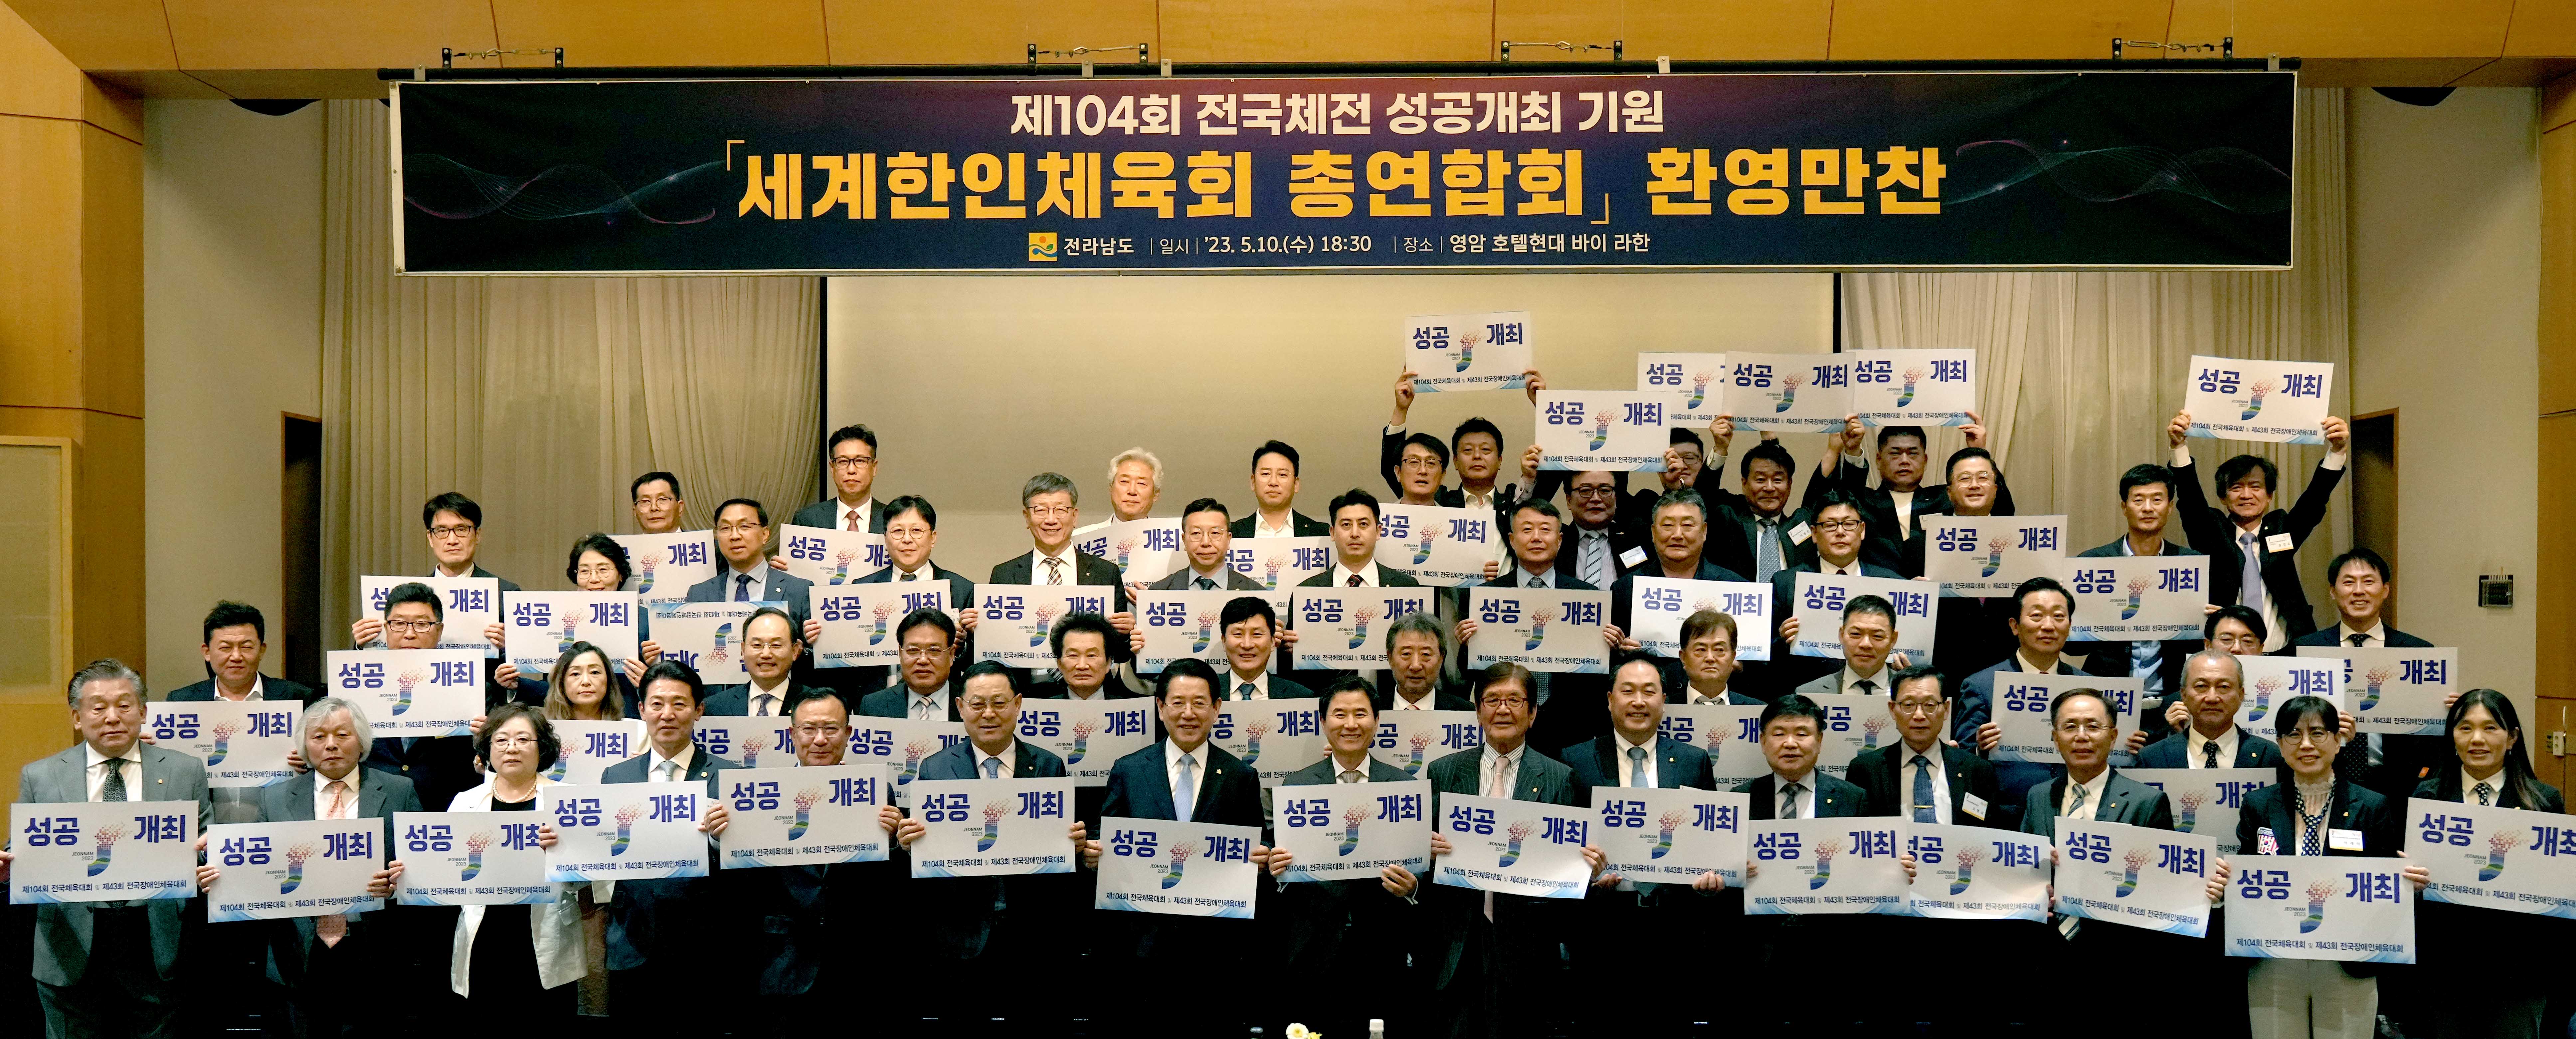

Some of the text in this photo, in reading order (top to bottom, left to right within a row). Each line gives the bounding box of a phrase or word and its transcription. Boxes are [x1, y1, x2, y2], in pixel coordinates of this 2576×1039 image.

[1011, 90, 1663, 135] 제104회 전국체전 성공개최 기원
[1647, 146, 1946, 215] 환영만찬
[1064, 238, 1134, 256] 전라남도
[1160, 239, 1188, 254] 일시
[1322, 236, 1371, 252] 18:30
[1404, 237, 1433, 252] 장소
[1450, 234, 1485, 253] 영암
[1492, 233, 1564, 252] 호텔현대
[1572, 234, 1606, 252] 바이
[1615, 233, 1650, 252] 라한
[1413, 323, 1522, 349] 성공 개최
[1484, 373, 1526, 382] 전국장애인체육대회
[1647, 364, 1683, 385] 성공
[1734, 364, 1847, 388] 성공 개최
[1855, 360, 1966, 383] 성공 개최
[2199, 369, 2322, 398] 성공 개최
[1546, 402, 1661, 426] 성공 개최
[1143, 529, 1179, 551] 개최
[1448, 519, 1486, 543] 개최
[1936, 527, 2057, 551] 성공 개최
[668, 542, 706, 566] 개최
[789, 536, 826, 561] 성공
[1292, 548, 1329, 570] 개최
[2073, 568, 2199, 594] 성공 개최
[450, 589, 488, 612] 개최
[821, 597, 861, 621] 성공
[984, 596, 1024, 619] 성공
[1642, 588, 1762, 616] 성공 개최
[1804, 585, 1845, 610] 성공
[513, 603, 628, 626] 성공 개최
[1146, 603, 1187, 626] 성공
[1303, 599, 1343, 622] 성공
[1480, 599, 1601, 626] 성공 개최
[1499, 655, 1529, 663] 전국체육대회
[339, 661, 473, 688] 성공 개최
[2289, 670, 2333, 695] 개최
[2400, 660, 2446, 684] 개최
[2004, 685, 2049, 712] 성공
[152, 712, 291, 739] 성공 개최
[1018, 710, 1146, 736] 성공 개최
[1277, 711, 1319, 736] 개최
[585, 733, 627, 758] 개최
[849, 729, 893, 756] 성공
[1441, 724, 1483, 749] 개최
[731, 778, 875, 811] 성공 개최
[922, 791, 1063, 822] 성공 개최
[555, 794, 695, 827] 성공 개최
[1284, 794, 1421, 827] 성공 개최
[1602, 800, 1738, 833] 성공 개최
[25, 815, 185, 846] 성공 개최
[405, 825, 453, 851] 성공
[1450, 806, 1587, 847] 성공 개최
[2419, 813, 2474, 846] 성공
[220, 832, 372, 866] 성공 개최
[757, 847, 793, 856] 전국체육대회
[824, 843, 878, 853] 전국장애인체육대회
[1111, 830, 1250, 863] 성공 개최
[1754, 830, 1896, 860] 성공 개최
[1992, 842, 2040, 869] 개최
[2066, 832, 2204, 878] 성공 개최
[52, 884, 92, 892] 전국체육대회
[127, 880, 186, 889] 전국장애인체육대회
[2238, 870, 2400, 903] 성공 개최
[2442, 884, 2515, 900] 전국체육대회 제43회
[1131, 894, 1165, 903] 전국체육대회
[1195, 898, 1246, 908] 전국장애인체육대회
[2265, 940, 2305, 949] 전국체육대회
[2316, 942, 2337, 950] 제43회
[2340, 943, 2403, 952] 전국장애인체육대회
